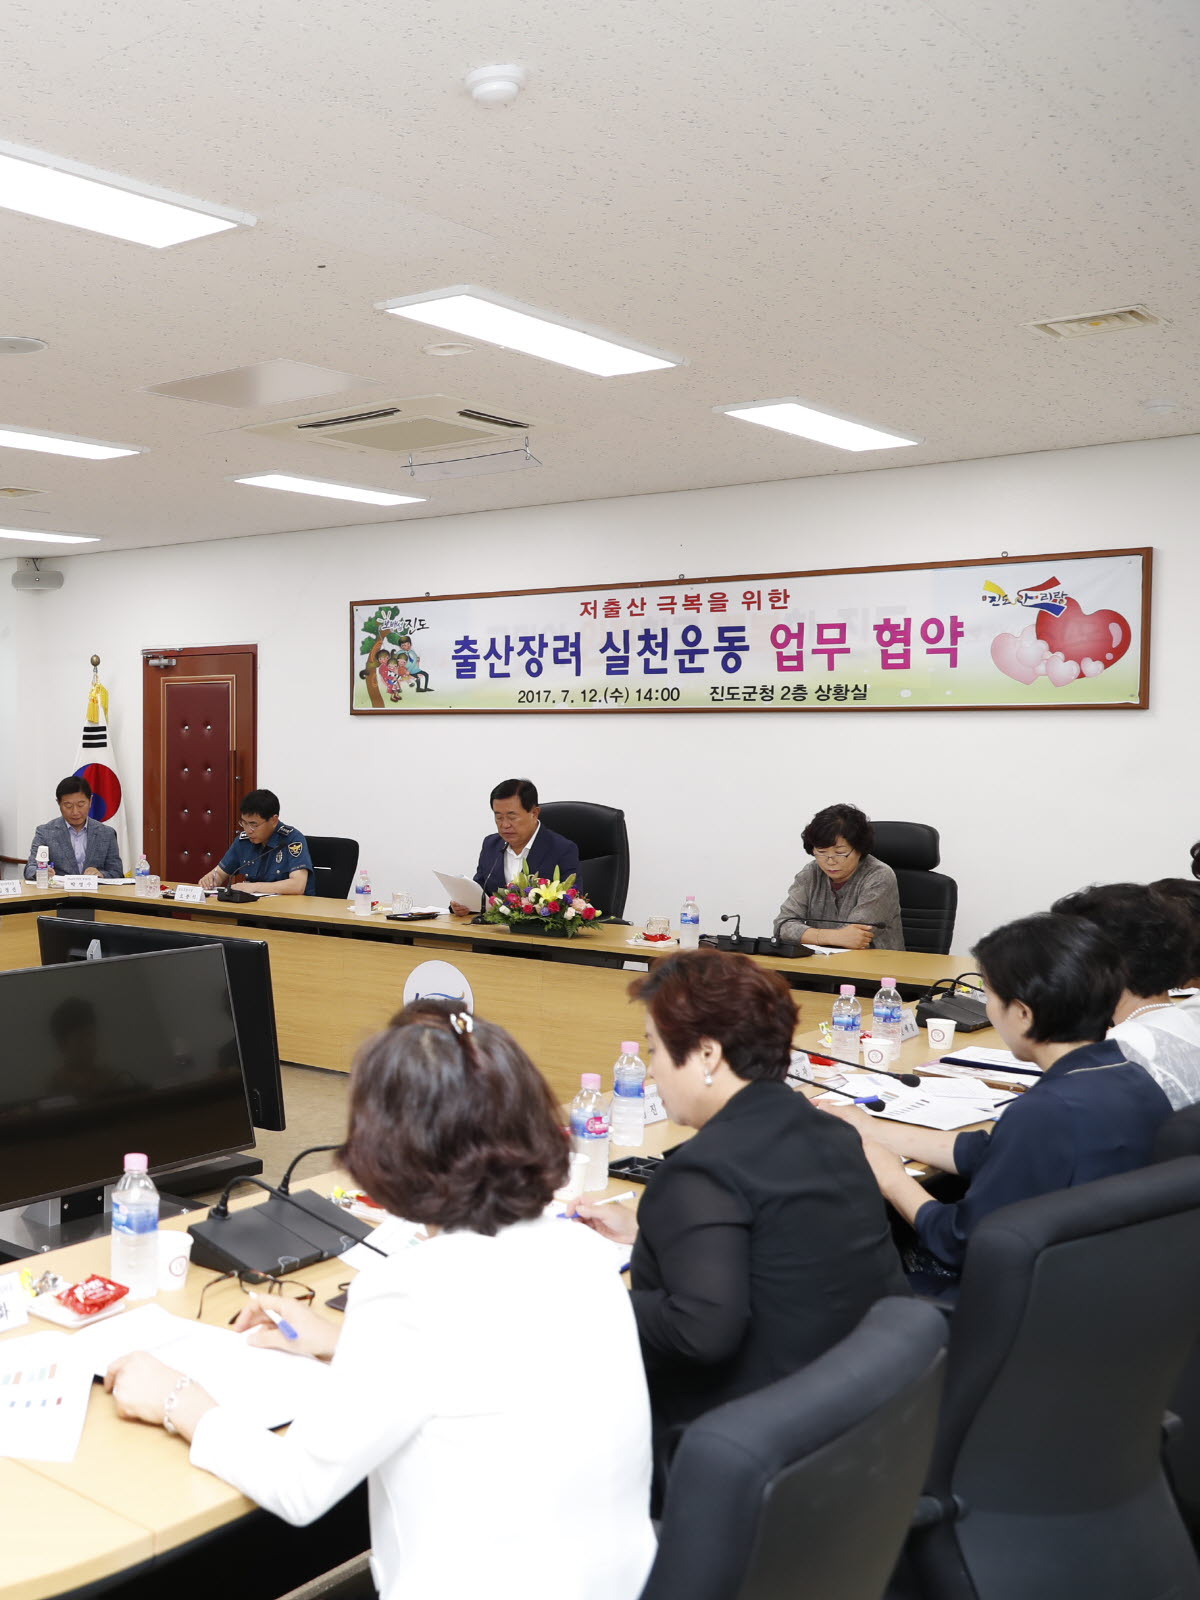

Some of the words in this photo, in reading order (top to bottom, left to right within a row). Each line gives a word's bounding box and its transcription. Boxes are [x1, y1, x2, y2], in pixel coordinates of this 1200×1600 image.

[580, 597, 647, 620] 저출산
[656, 591, 729, 615] 극복을
[741, 588, 791, 611] 위한
[451, 631, 582, 680] 출산장려
[599, 624, 750, 676] 실천운동
[769, 622, 851, 673] 업무
[872, 615, 965, 671] 협약
[518, 690, 556, 704] 2017.
[561, 689, 574, 704] 7.
[636, 687, 681, 702] 14:00
[709, 684, 775, 702] 진도군청
[781, 685, 809, 702] 2층
[814, 684, 868, 702] 상황실
